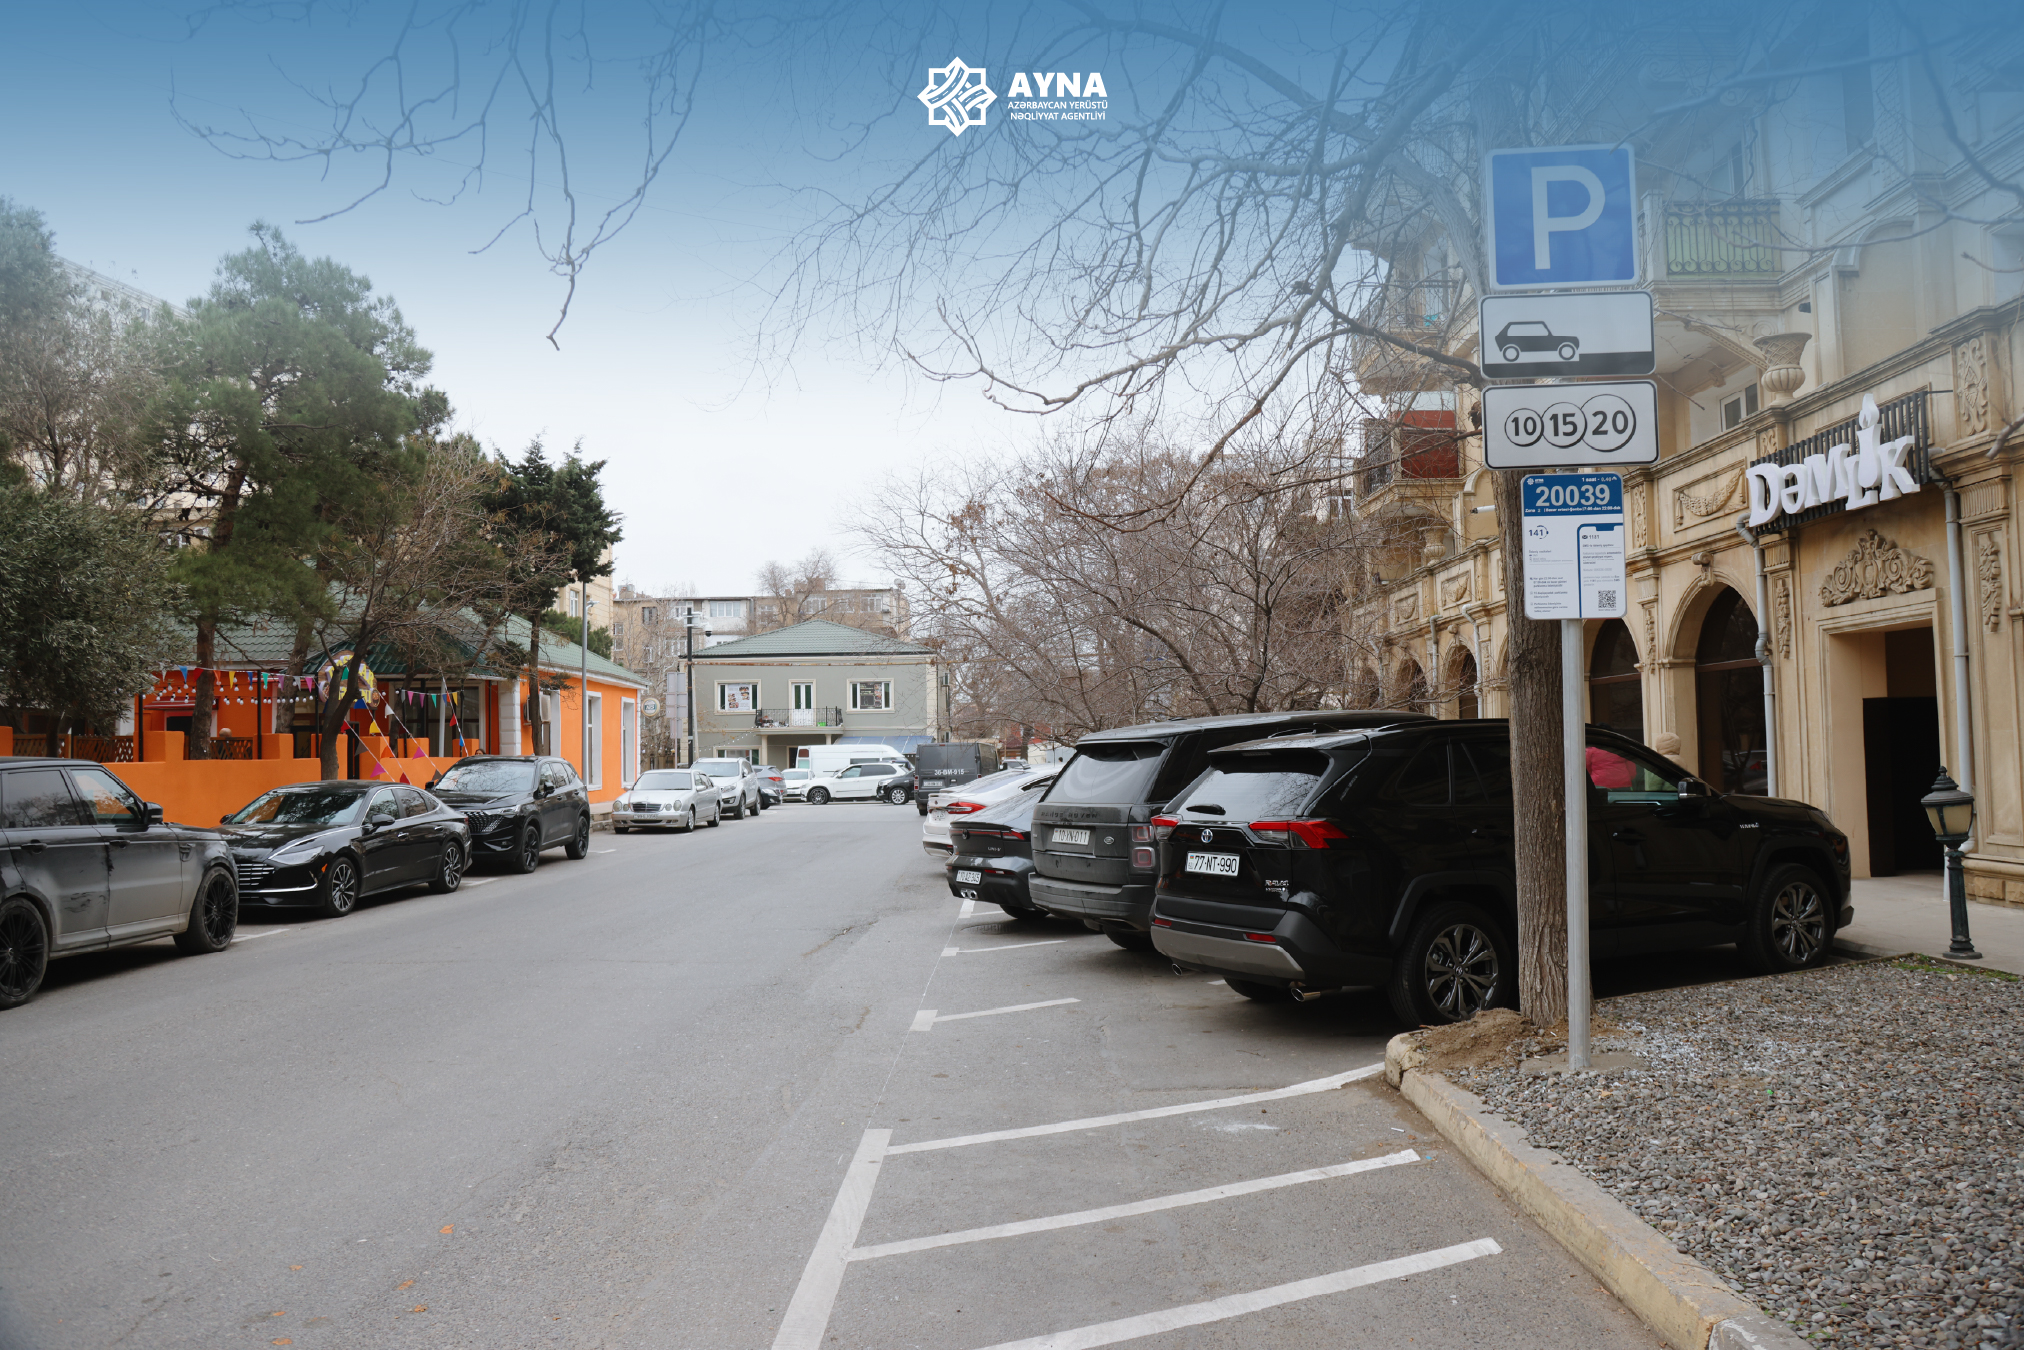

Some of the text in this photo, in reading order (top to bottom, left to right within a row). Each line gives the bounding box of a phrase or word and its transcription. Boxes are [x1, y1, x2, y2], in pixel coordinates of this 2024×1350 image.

[1531, 165, 1605, 270] P
[1511, 410, 1629, 437] 10 15 20
[1535, 484, 1610, 507] 20039
